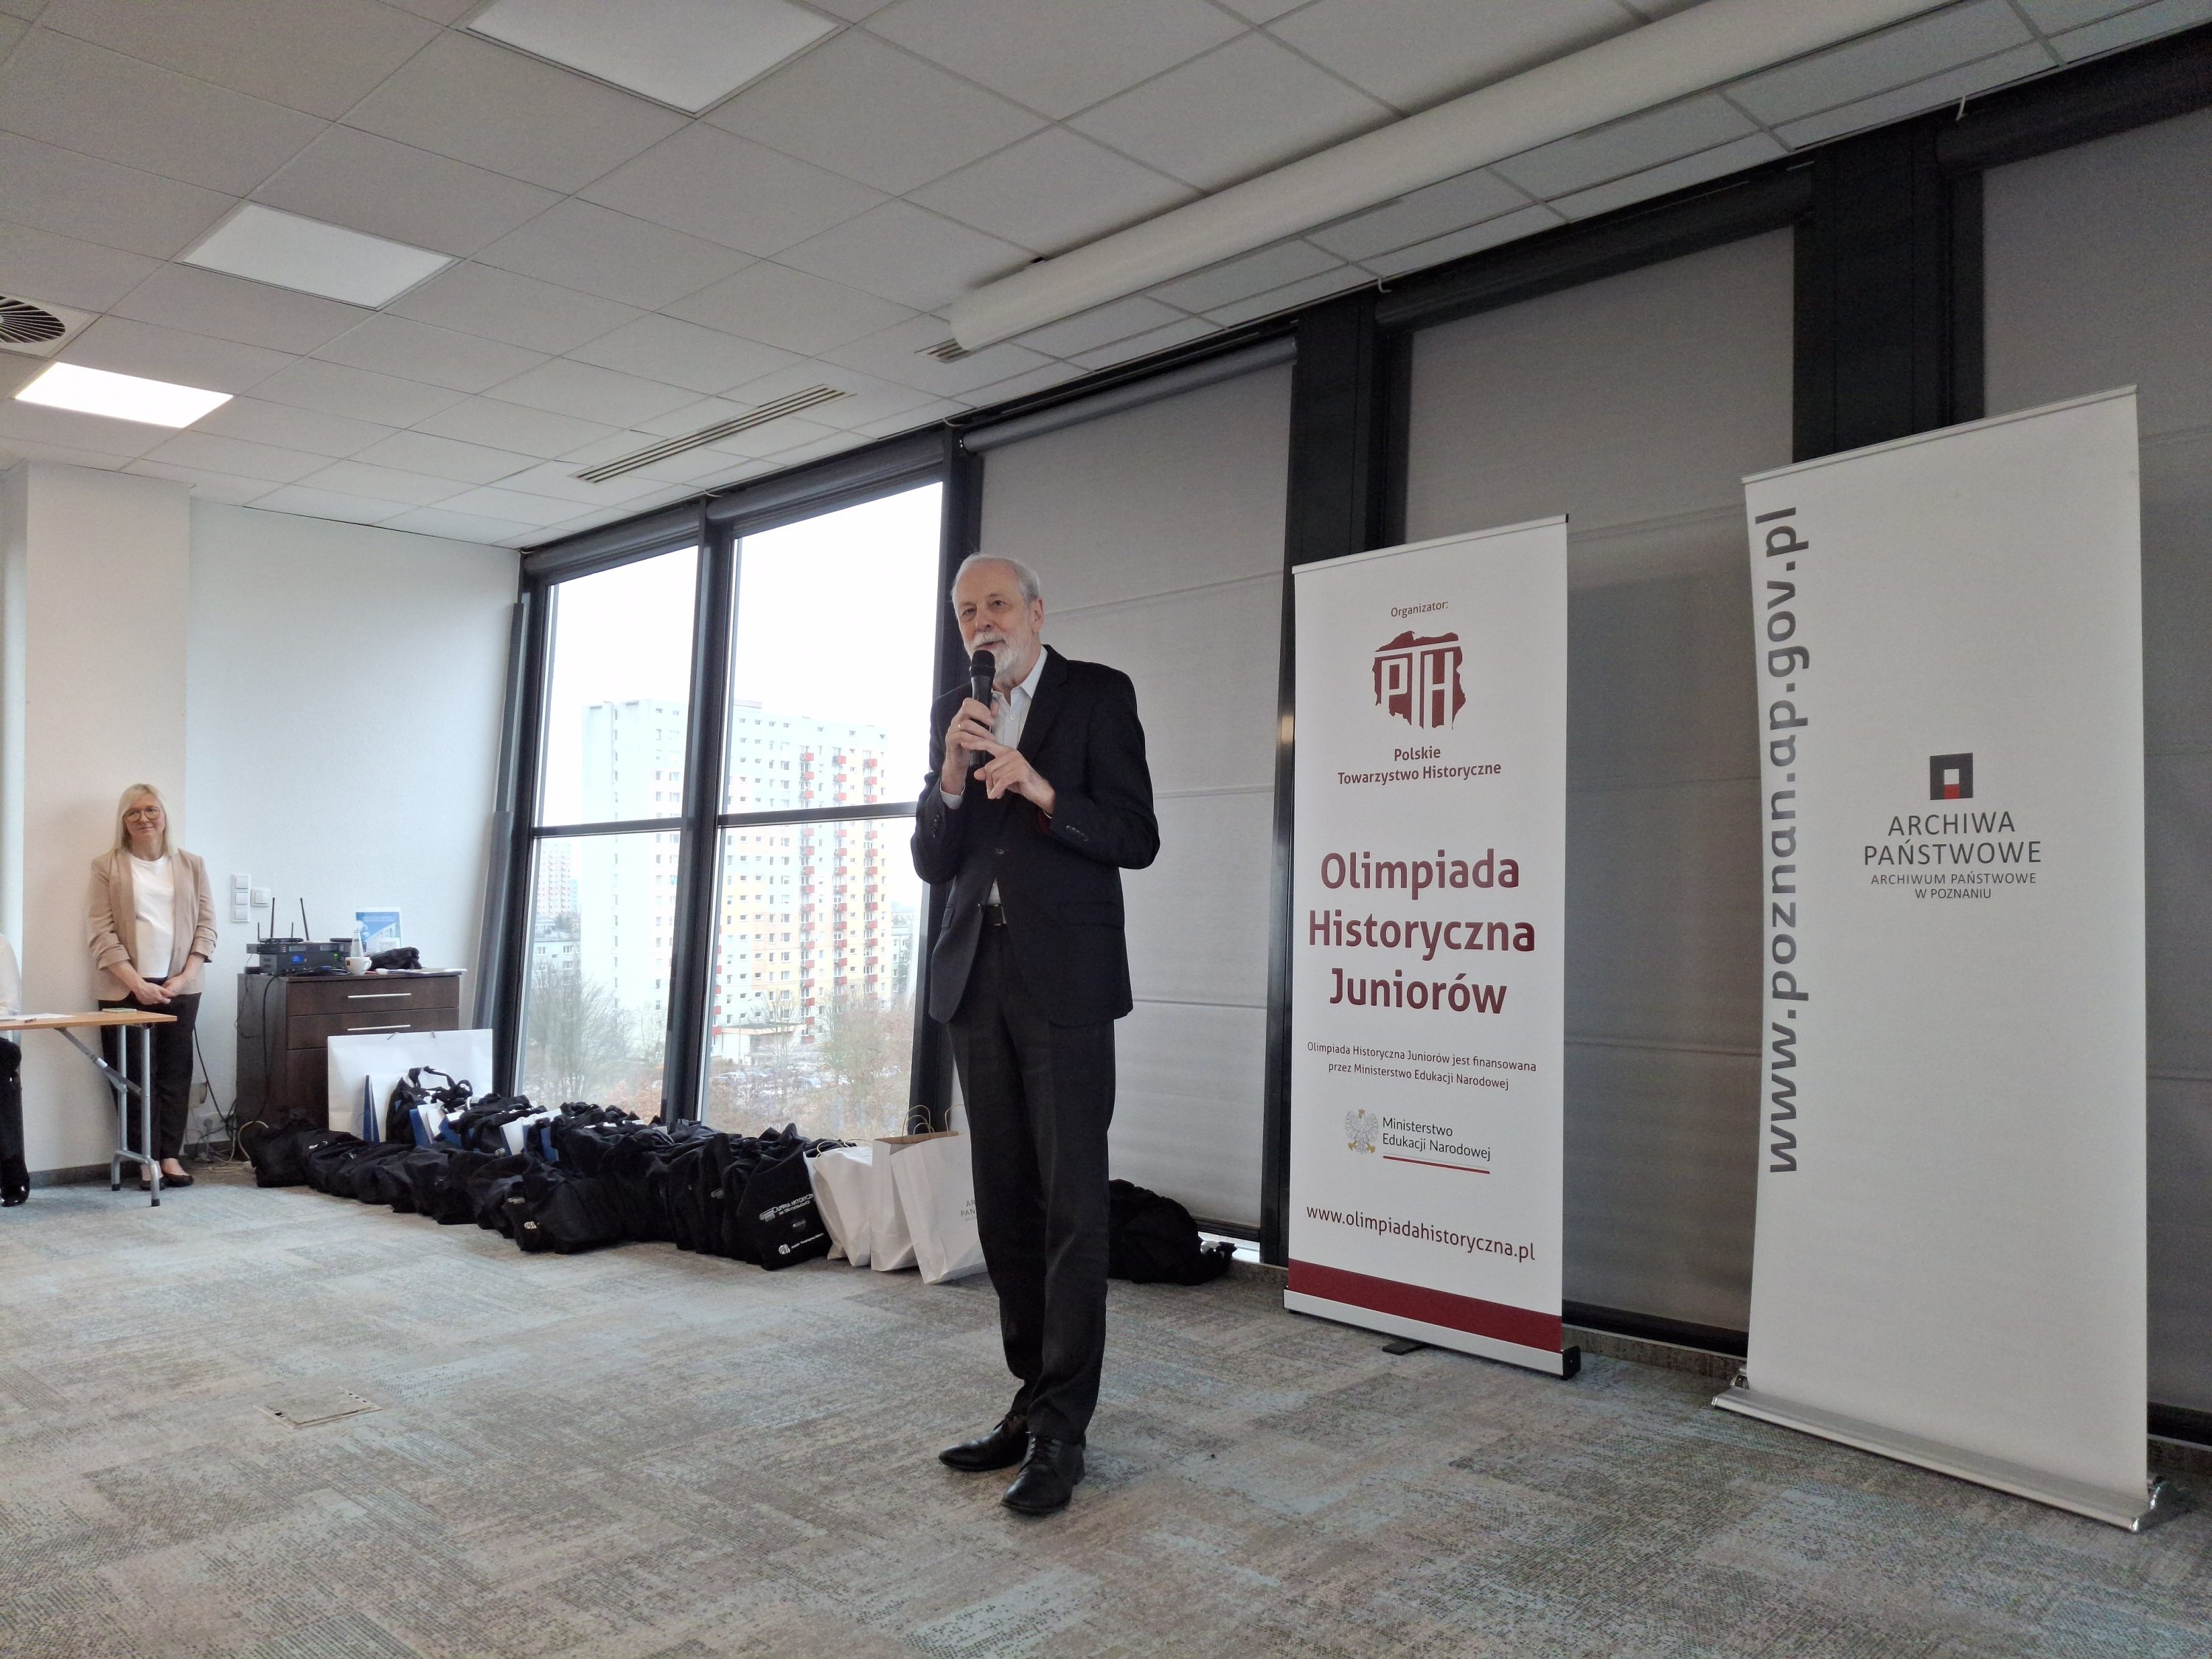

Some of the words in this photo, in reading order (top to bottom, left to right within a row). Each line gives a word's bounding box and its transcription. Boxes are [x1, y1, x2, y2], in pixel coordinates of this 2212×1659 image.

[1391, 601, 1449, 619] Organizator:
[1394, 745, 1441, 762] Polskie
[1338, 770, 1419, 786] Towarzystwo
[1422, 762, 1502, 781] Historyczne
[1888, 810, 2016, 837] ARCHIWA
[1755, 507, 1810, 1173] www.poznan.ap.gov.pl
[1864, 838, 2042, 866] PAŃSTWOWE
[1321, 848, 1520, 900] Olimpiada
[1871, 874, 1946, 885] ARCHIWUM
[1951, 870, 2037, 884] PAŃSTWOWE
[1915, 888, 1927, 899] W
[1930, 888, 1992, 899] POZNANIU
[1309, 908, 1535, 961] Historyczna
[1329, 967, 1507, 1015] Juniorów
[1307, 1041, 1351, 1055] Olimpiada
[1353, 1045, 1405, 1060] Historyczna
[1407, 1050, 1450, 1064] Juniorów
[1452, 1054, 1470, 1067] jest
[1472, 1055, 1537, 1072] finansowana
[1328, 1062, 1352, 1074] przez
[1354, 1063, 1412, 1079] Ministerstwo
[1414, 1069, 1454, 1085] Edukacji
[1456, 1074, 1509, 1091] Narodowej
[1382, 1116, 1453, 1137] Ministerstwo
[1382, 1133, 1426, 1152] Edukacji
[1429, 1139, 1491, 1162] Narodowej
[1307, 1206, 1536, 1263] www.olimpiadahistoryczna.pl
